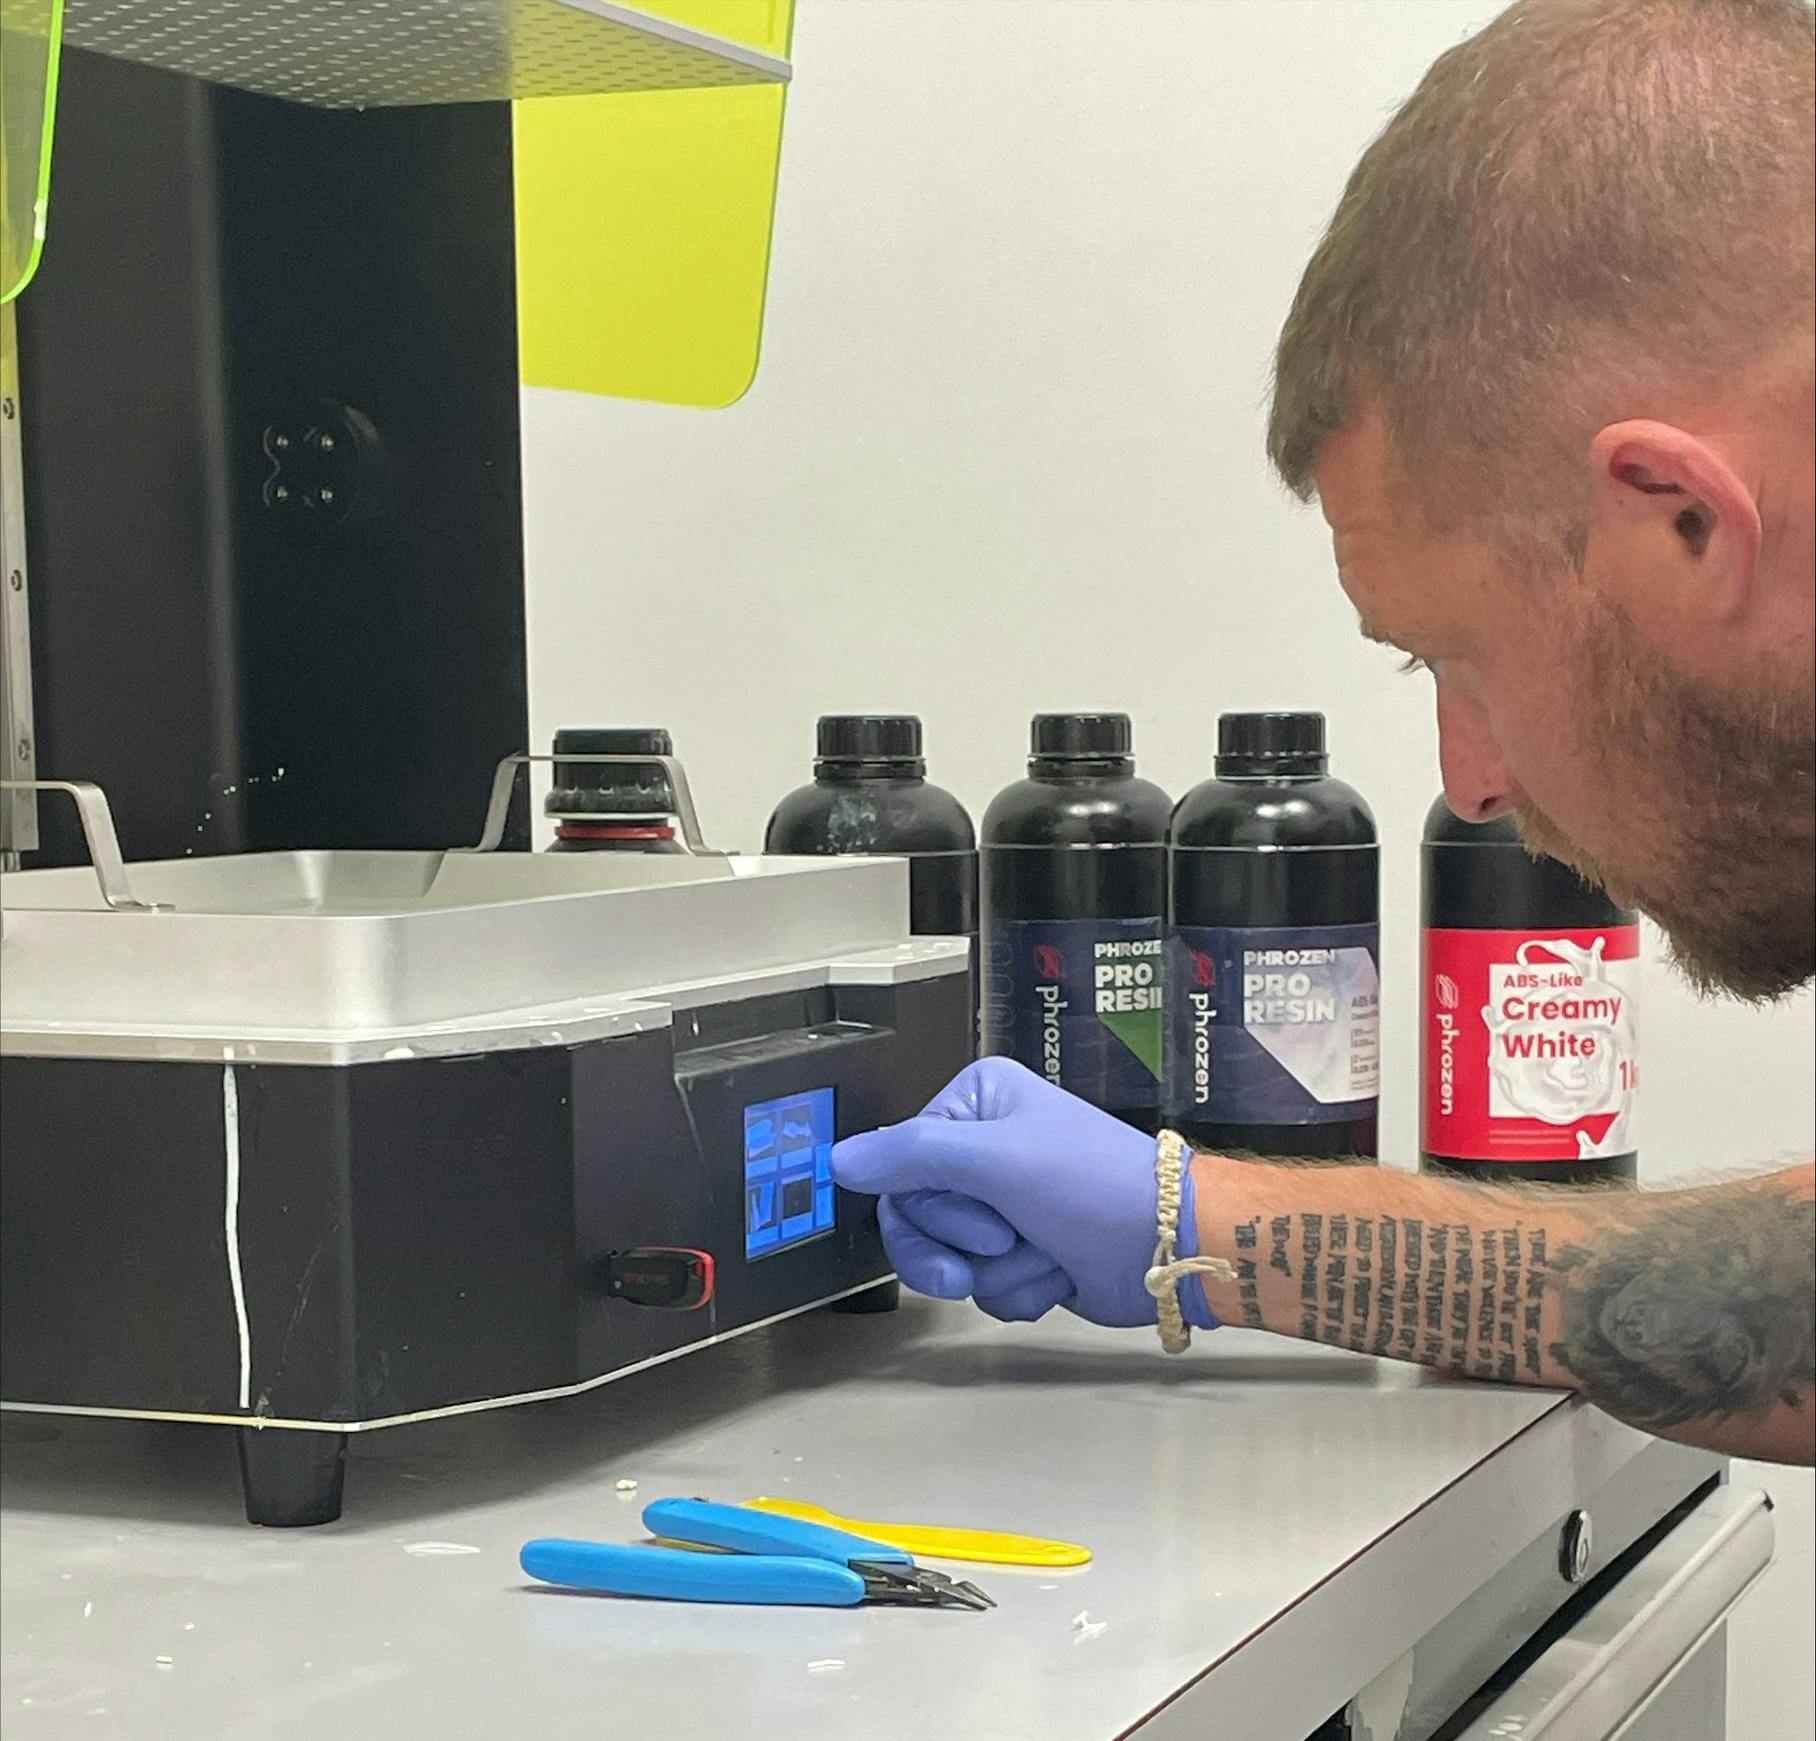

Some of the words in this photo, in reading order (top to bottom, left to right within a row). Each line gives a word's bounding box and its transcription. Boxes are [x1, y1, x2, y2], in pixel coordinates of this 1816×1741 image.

[1094, 940, 1162, 959] PHROZE
[1243, 949, 1336, 966] PHROZEN
[1095, 963, 1153, 988] PRO
[1243, 973, 1311, 998] PRO
[1503, 973, 1584, 989] ABS-Like
[1243, 999, 1336, 1024] RESIN
[1502, 996, 1622, 1026] Creamy
[1189, 993, 1217, 1104] phrozen
[1502, 1031, 1596, 1058] White
[1436, 1013, 1460, 1116] phrozen
